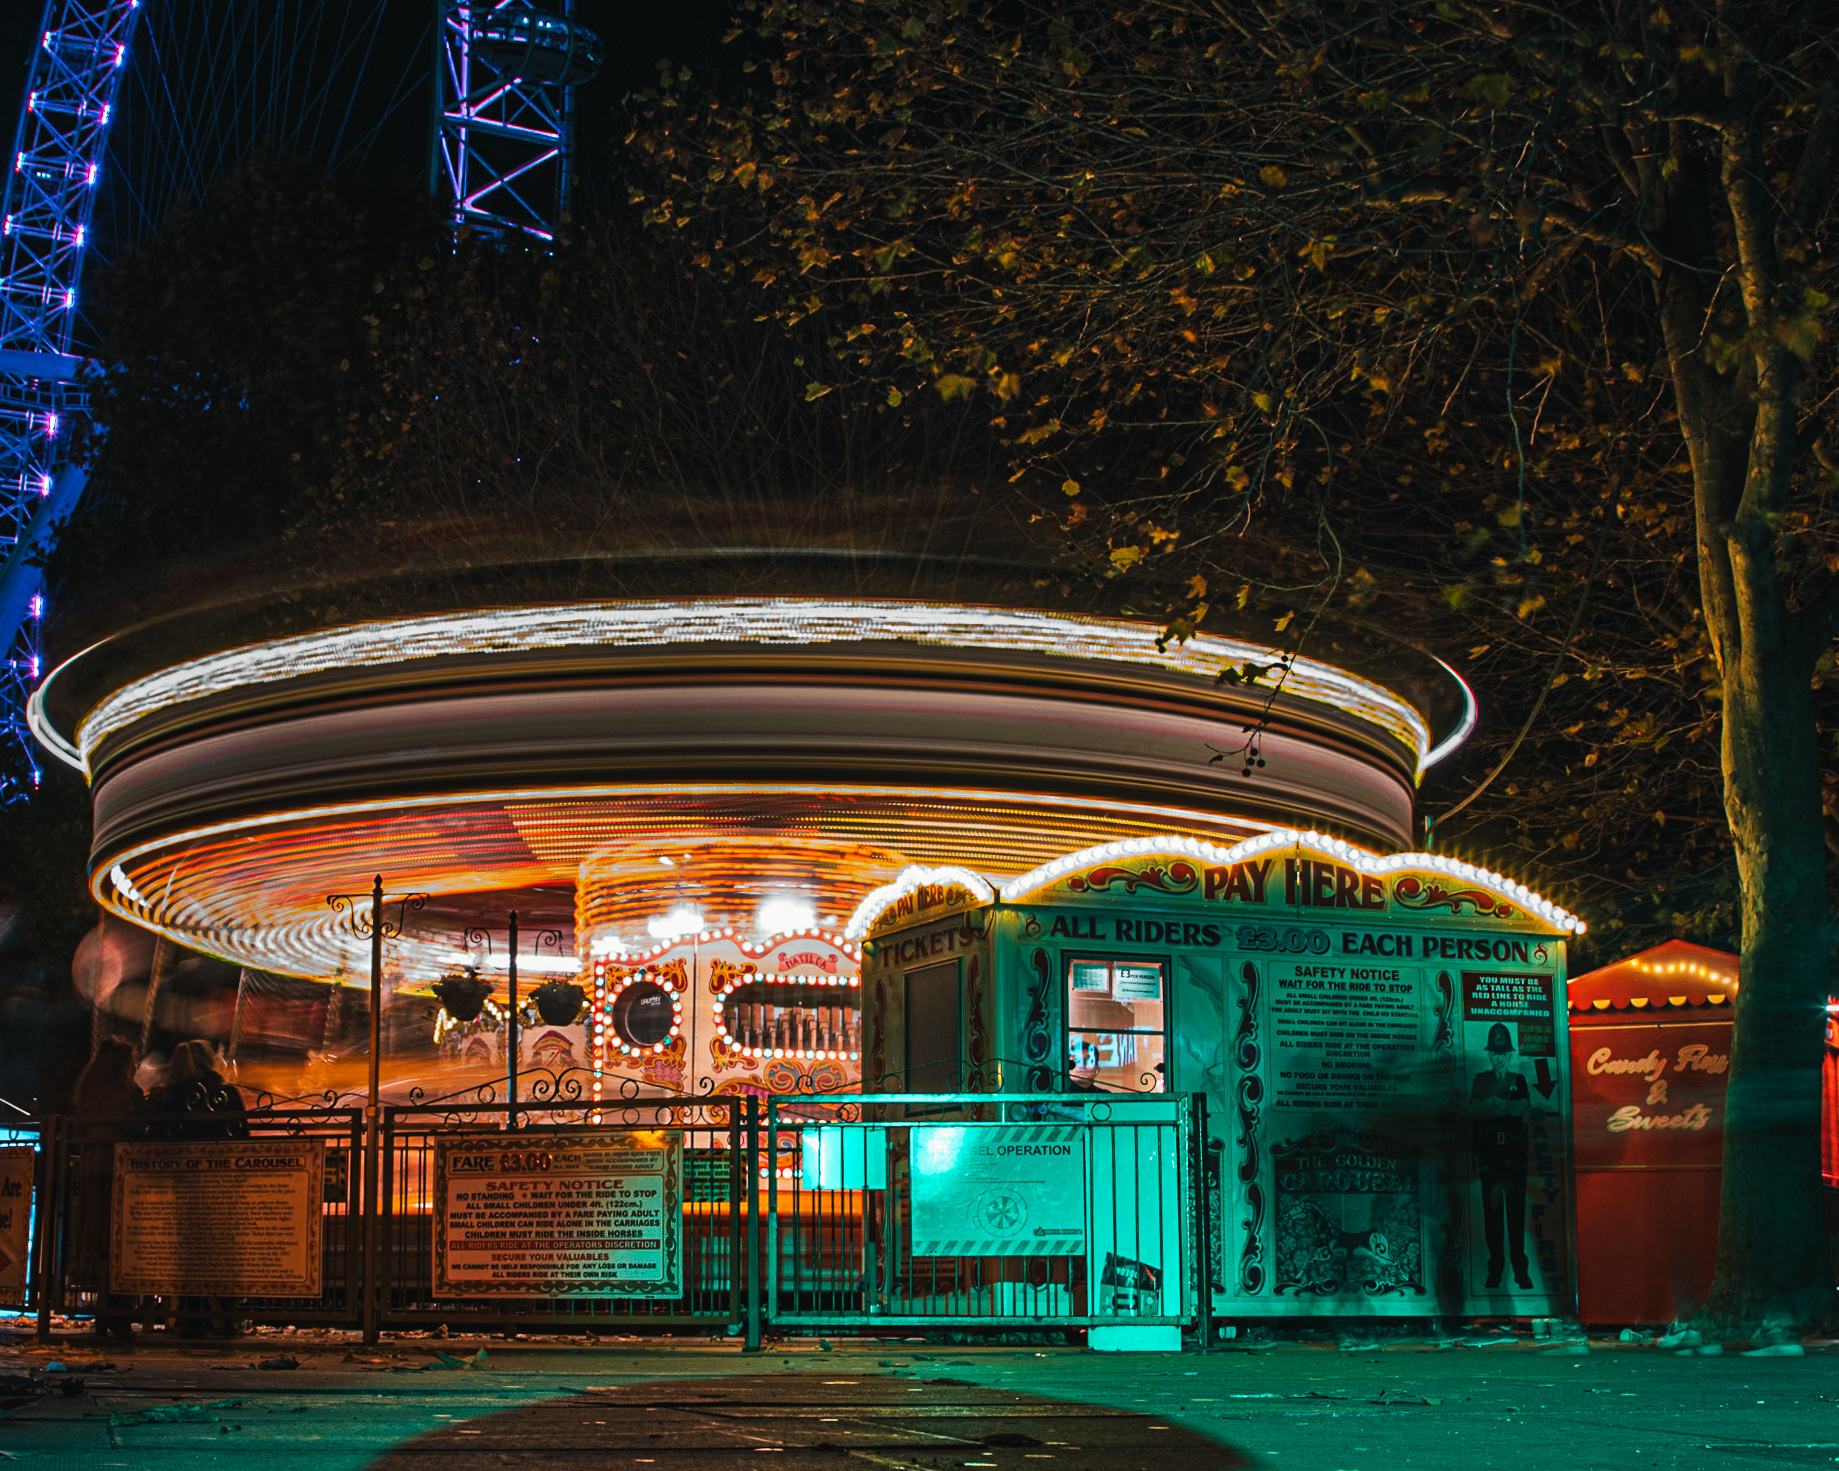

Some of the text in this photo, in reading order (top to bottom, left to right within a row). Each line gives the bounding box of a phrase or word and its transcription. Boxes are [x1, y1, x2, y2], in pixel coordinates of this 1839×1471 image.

[1204, 858, 1385, 910] PAY HERE
[898, 884, 944, 917] PAY HERE
[882, 927, 974, 967] TICKETS
[1051, 915, 1528, 963] ALL RIDERS £3.00 EACH PERSON
[785, 954, 826, 970] MATILDA
[1121, 969, 1130, 978] £3
[1295, 966, 1399, 981] SAFETY NOTICE
[1279, 979, 1412, 992] WAIT FOR THE RIDE TO STOP
[1471, 1008, 1550, 1017] UNACCOMPANIED
[1587, 1047, 1667, 1081] Candy
[1646, 1080, 1668, 1105] &
[1606, 1103, 1712, 1132] Sweets
[997, 1145, 1071, 1155] OPERATION
[130, 1158, 303, 1169] HISTORY OF THE CAROUSEL
[452, 1152, 581, 1172] FARE £3.00 EACH
[1296, 1154, 1396, 1171] THE GOLDEN
[2, 1176, 22, 1197] Are
[486, 1180, 624, 1191] SAFETY NOTICE
[1280, 1170, 1416, 1192] CAROUSEL
[471, 1192, 514, 1200] STANDING
[620, 1190, 633, 1198] TO
[634, 1190, 657, 1198] STOP
[589, 1200, 604, 1208] 4ft.
[606, 1200, 642, 1209] (122cm.)
[489, 1211, 548, 1219] ACCOMPANIED
[491, 1253, 527, 1261] SECURE
